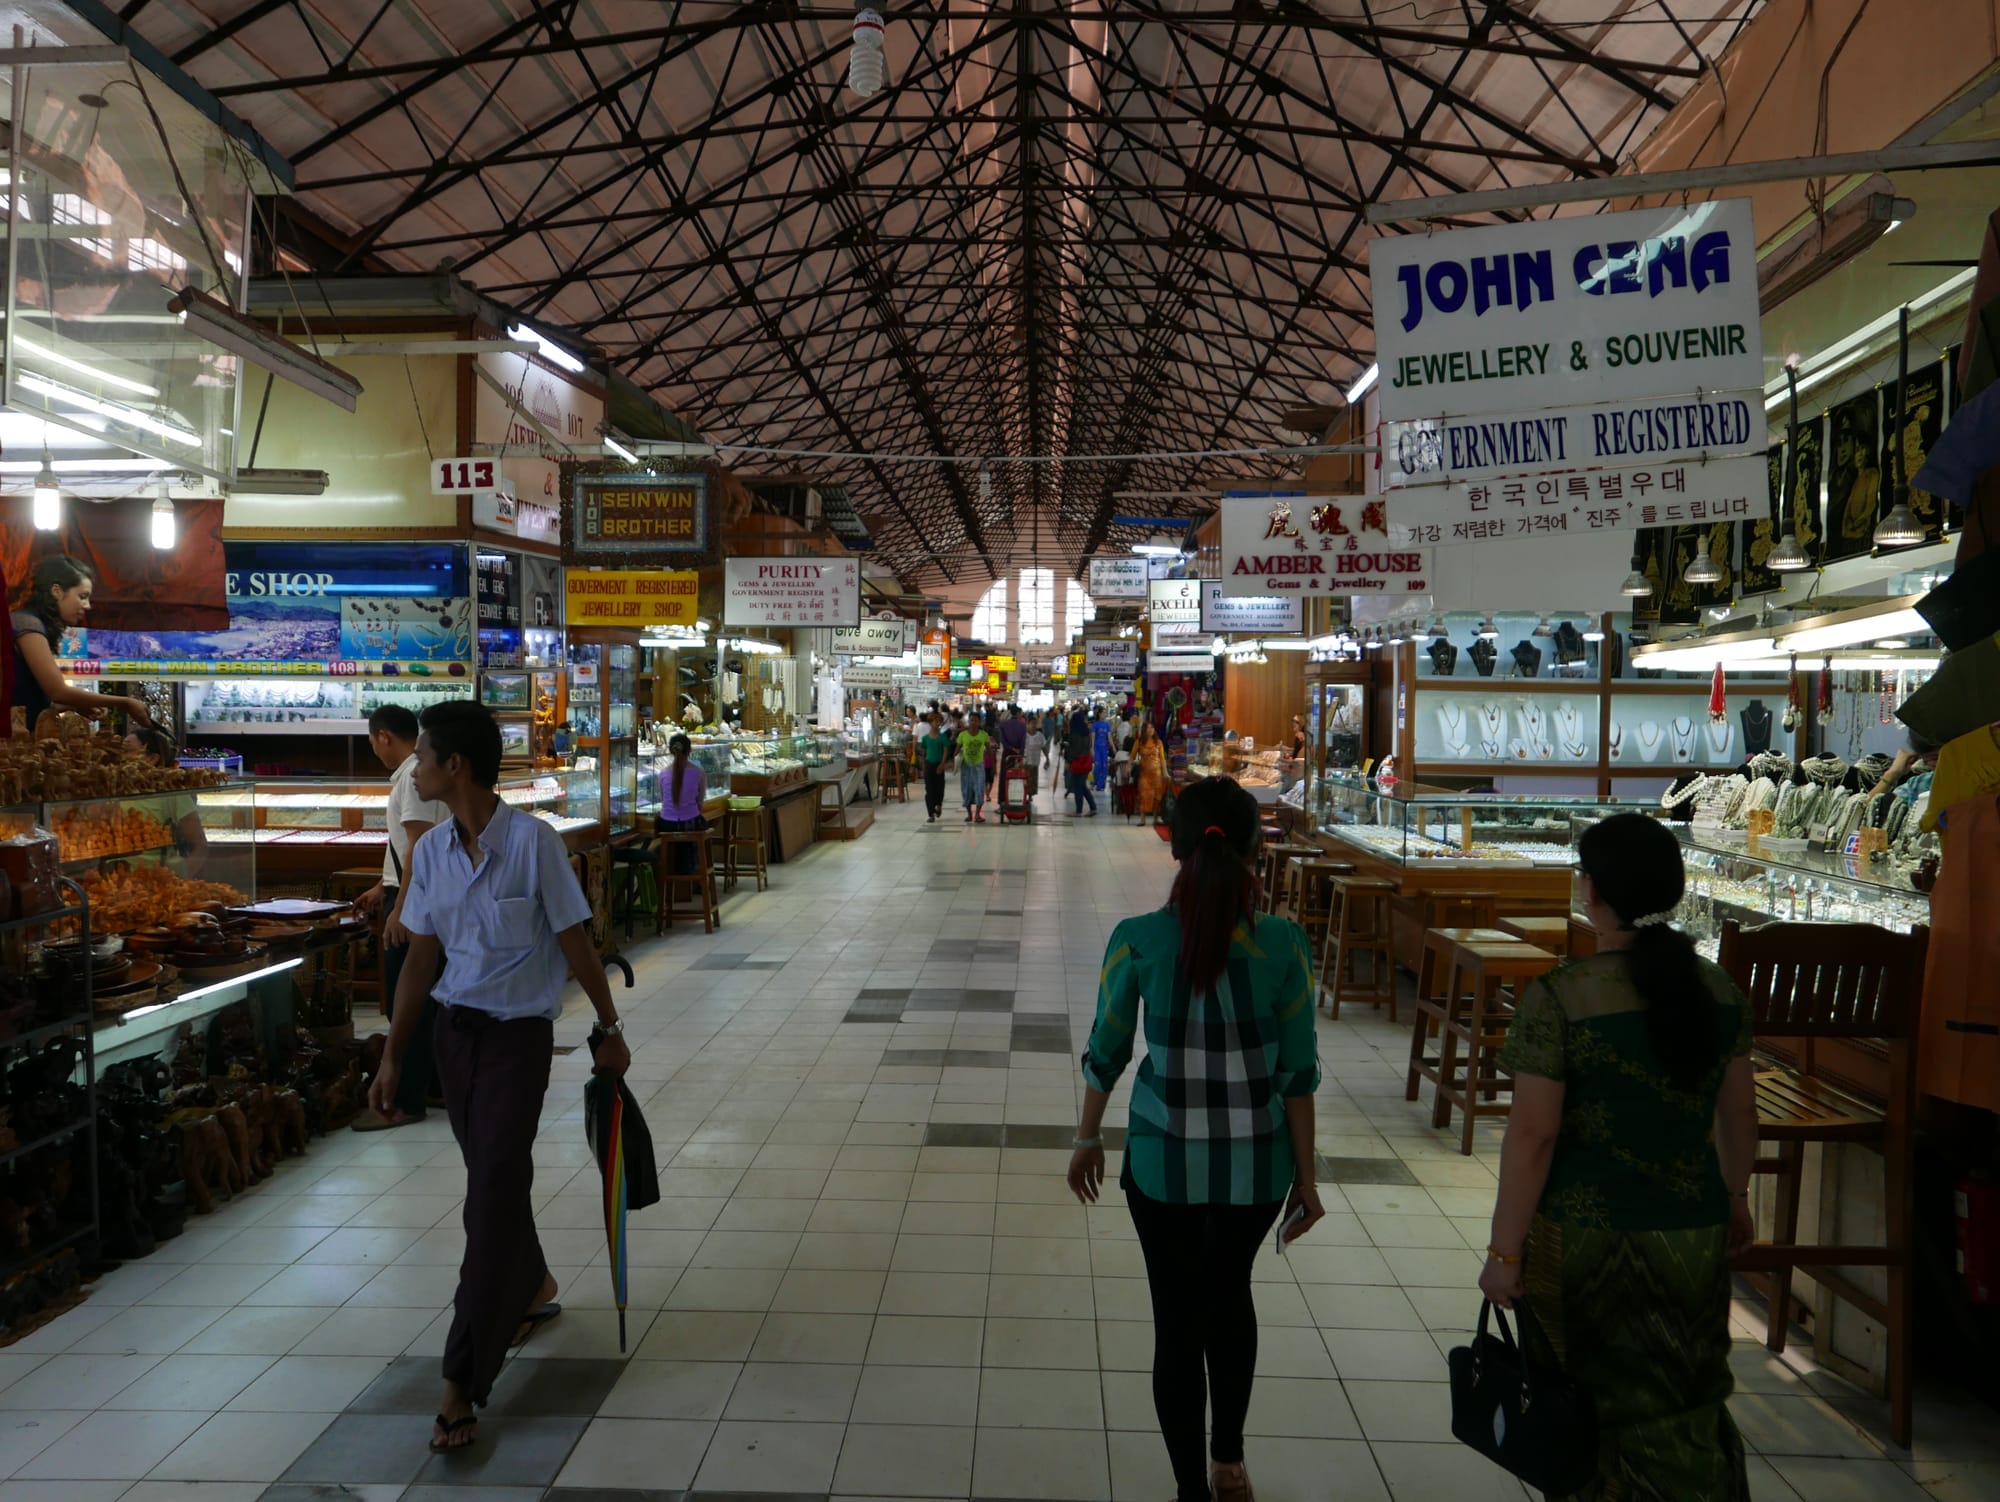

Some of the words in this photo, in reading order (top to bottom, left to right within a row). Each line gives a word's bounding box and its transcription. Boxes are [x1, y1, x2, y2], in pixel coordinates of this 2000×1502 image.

[1398, 249, 1555, 333] JOHN
[1573, 231, 1732, 299] CENA
[1393, 343, 1550, 388] JEWELLERY
[1570, 341, 1588, 371] &
[1606, 324, 1747, 368] SOUVENIR
[567, 412, 583, 440] 107
[1399, 416, 1567, 475] GOVERNMENT
[1592, 400, 1751, 457] REGISTERED
[440, 462, 493, 488] 113
[544, 472, 553, 497] &
[603, 519, 692, 534] BROTHER
[1453, 519, 1505, 541] 저렴한
[1518, 512, 1567, 535] 가격에
[758, 565, 824, 578] PURITY
[1232, 555, 1325, 576] AMBER
[1336, 552, 1422, 574] HOUSE
[250, 572, 334, 597] SHOP
[568, 579, 627, 594] GOVERMENT
[636, 579, 697, 595] REGISTERED
[1267, 578, 1301, 590] Gems
[1309, 578, 1319, 588] &
[1329, 577, 1386, 591] Jewellery
[1407, 580, 1426, 591] 109
[582, 602, 641, 617] JEWELLERY
[655, 602, 683, 617] SHOP
[1214, 602, 1235, 610] GEMS
[1247, 602, 1291, 610] JEWELLERY
[835, 626, 861, 637] Give
[868, 628, 900, 642] away
[74, 661, 99, 675] 107
[108, 662, 159, 675] SEIN
[166, 662, 208, 675] WIN
[216, 662, 323, 675] BROTHER
[330, 661, 356, 676] 108
